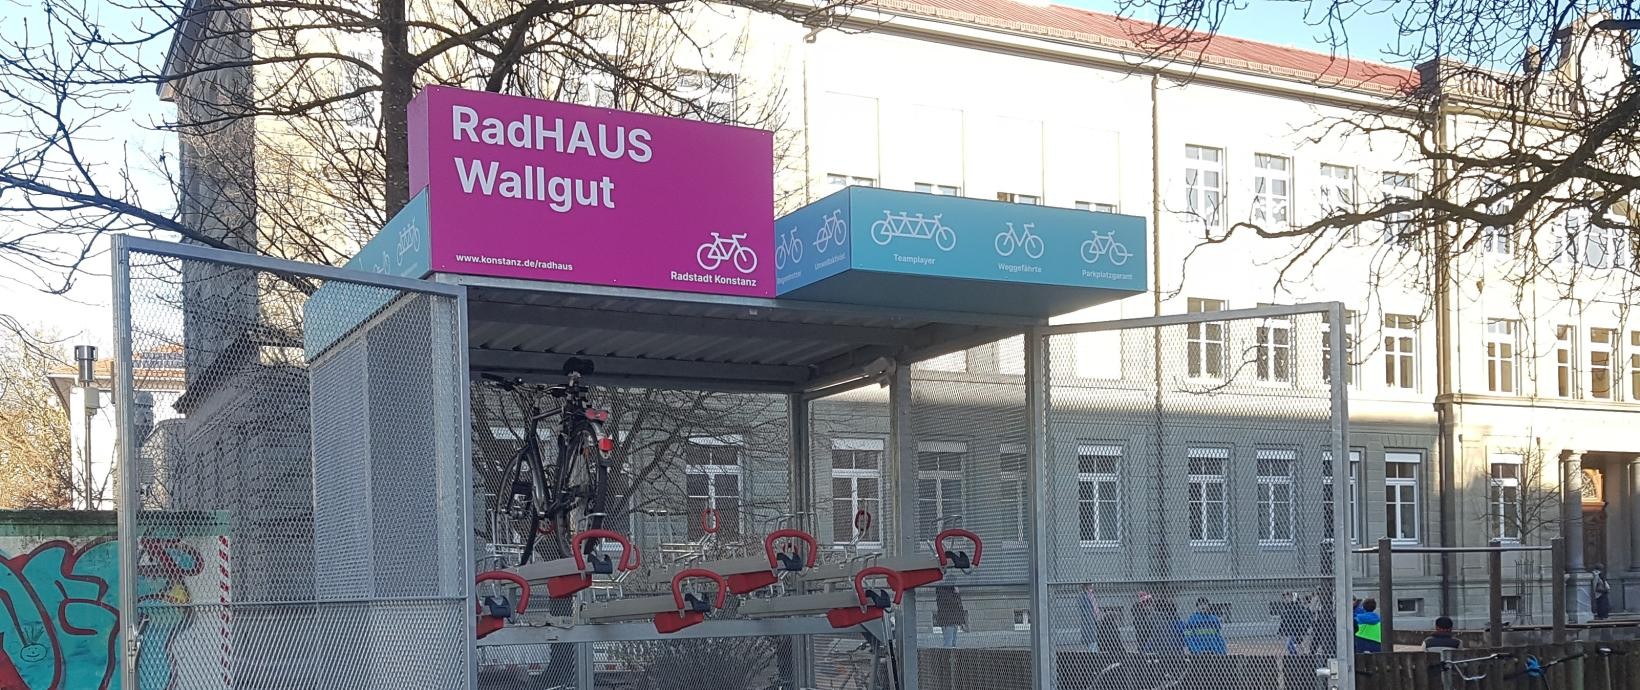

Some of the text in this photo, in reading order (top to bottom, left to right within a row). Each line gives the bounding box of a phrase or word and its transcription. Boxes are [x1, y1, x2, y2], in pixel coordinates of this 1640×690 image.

[452, 104, 653, 163] RadHAUS
[454, 157, 616, 213] Wallgut
[455, 254, 573, 271] www.konstanz.de/radhaus
[893, 253, 936, 265] Teamplayer
[998, 263, 1042, 273] Weggefährte
[670, 271, 757, 287] Radstadt Konstanz
